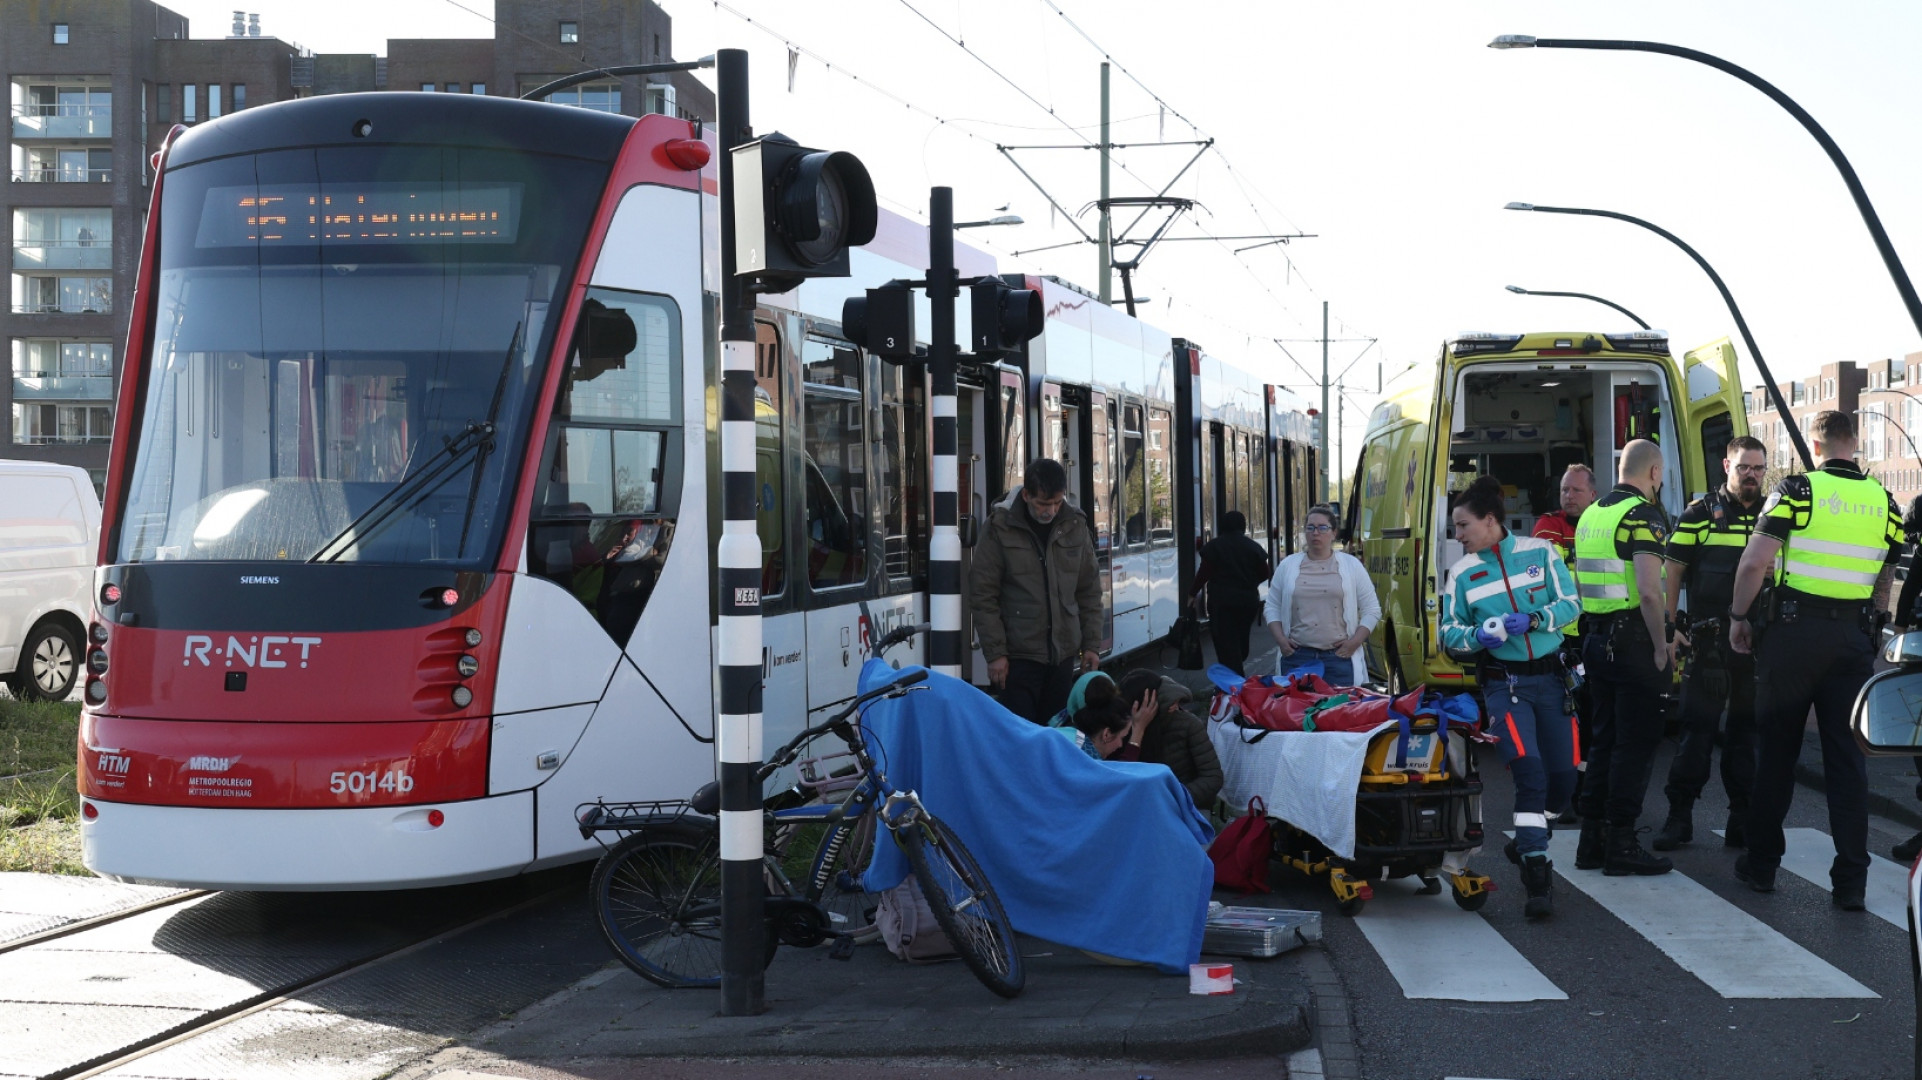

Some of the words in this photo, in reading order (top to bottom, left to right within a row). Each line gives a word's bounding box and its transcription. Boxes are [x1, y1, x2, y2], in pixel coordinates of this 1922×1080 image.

[750, 248, 757, 263] 2
[886, 337, 895, 348] 3
[982, 335, 987, 346] 1
[240, 575, 280, 584] SIEMENS
[98, 755, 131, 774] HTM
[190, 757, 229, 771] MRDH
[189, 777, 252, 787] METROPOOLREGIO
[330, 769, 414, 793] 5014b
[189, 787, 222, 797] ROTTERDAM
[222, 788, 235, 797] DEN
[235, 789, 252, 798] HAAG
[814, 825, 850, 890] BATAVUS
